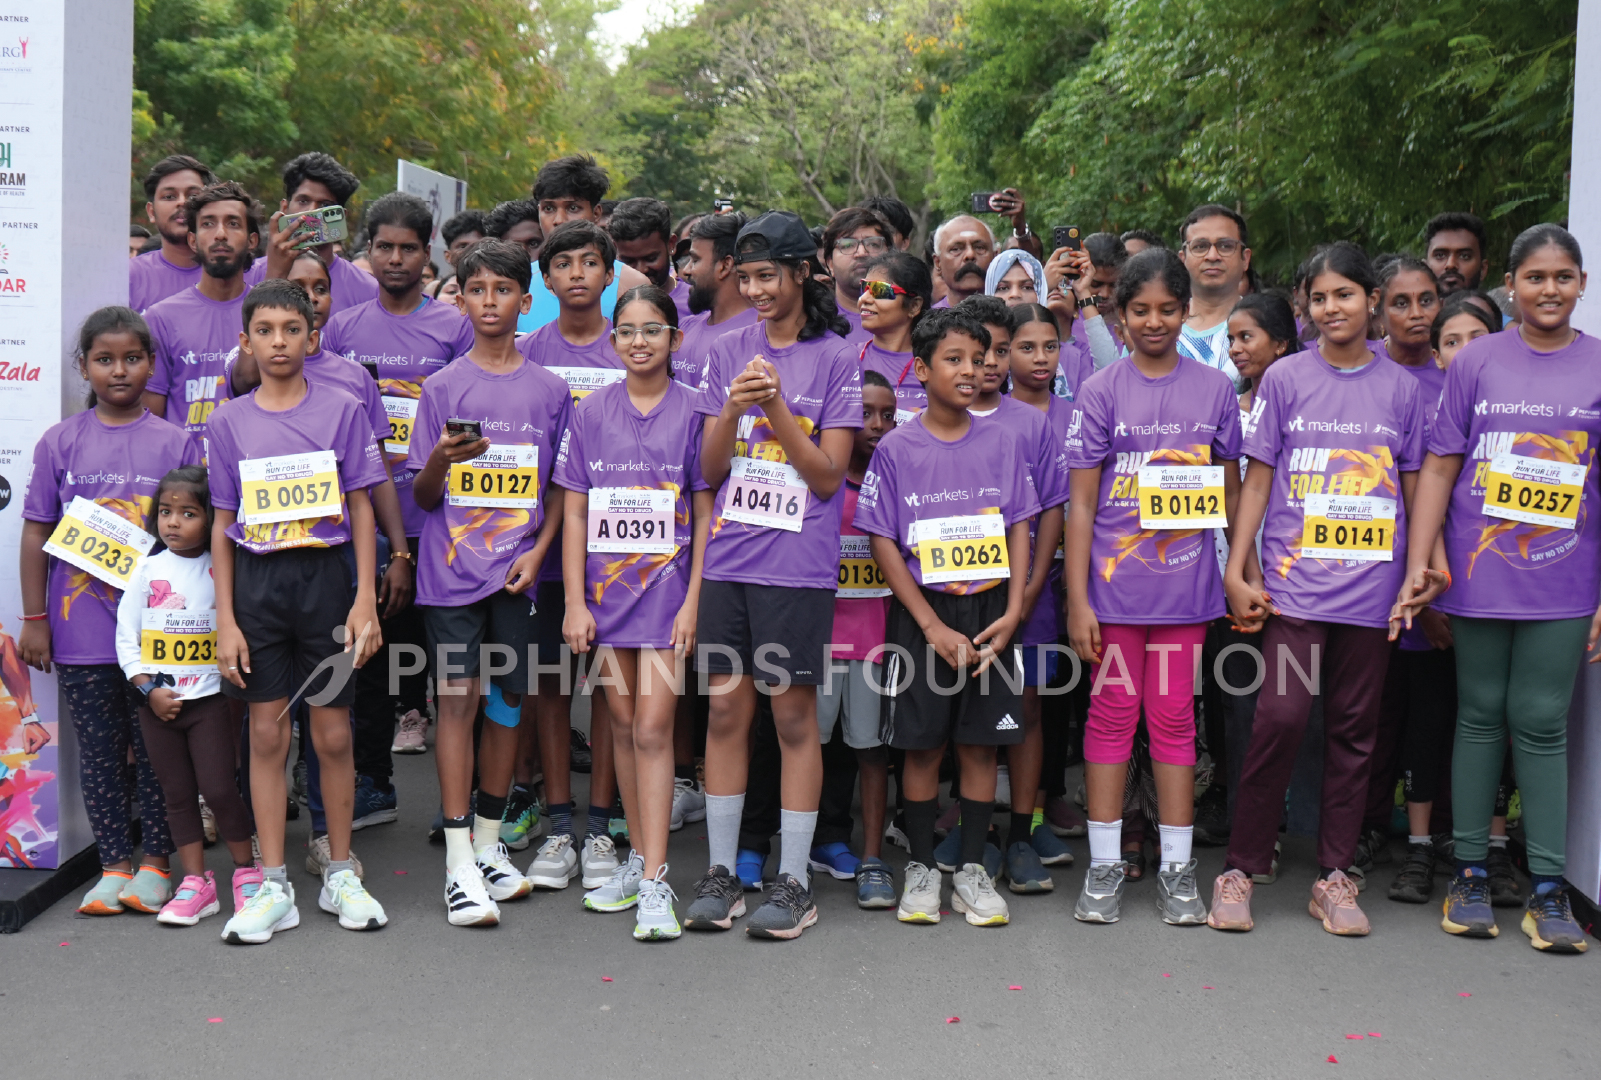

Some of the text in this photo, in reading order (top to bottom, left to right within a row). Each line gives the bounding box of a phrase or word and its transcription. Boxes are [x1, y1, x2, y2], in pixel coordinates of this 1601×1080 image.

[0, 278, 26, 293] AR
[180, 351, 198, 365] vt
[360, 353, 409, 366] markets
[0, 361, 41, 381] Zala
[397, 405, 410, 413] LIFE
[1475, 400, 1554, 417] vt markets
[481, 417, 510, 432] rkets
[1132, 420, 1181, 436] markets
[1289, 416, 1362, 435] vt markets
[1473, 432, 1517, 460] RUN
[590, 459, 651, 472] vt markets
[1114, 450, 1155, 475] RUN
[1289, 448, 1331, 472] RUN
[77, 470, 125, 484] markets
[394, 475, 404, 483] SAY
[758, 469, 771, 477] FOR
[771, 471, 786, 480] LIFE
[1531, 468, 1545, 476] FOR
[1545, 470, 1562, 478] LIFE
[461, 472, 532, 494] B 0127
[1288, 474, 1326, 500] FOR
[256, 482, 332, 510] B 0057
[732, 486, 799, 517] A 0416
[904, 489, 969, 508] vt markets
[1151, 495, 1219, 516] B 0142
[1497, 482, 1575, 514] B 0257
[1358, 506, 1372, 514] LIFE
[89, 514, 132, 539] RUN FOR LIFE
[598, 519, 666, 539] A 0391
[941, 525, 982, 535] RUN FOR LIFE
[1315, 525, 1385, 547] B 0141
[61, 526, 134, 575] B 0233
[506, 541, 514, 550] NO
[1532, 544, 1566, 562] SAY NO TO
[931, 544, 1003, 569] B 0262
[1169, 557, 1180, 566] SAY
[1180, 554, 1190, 563] NO
[153, 639, 167, 661] B
